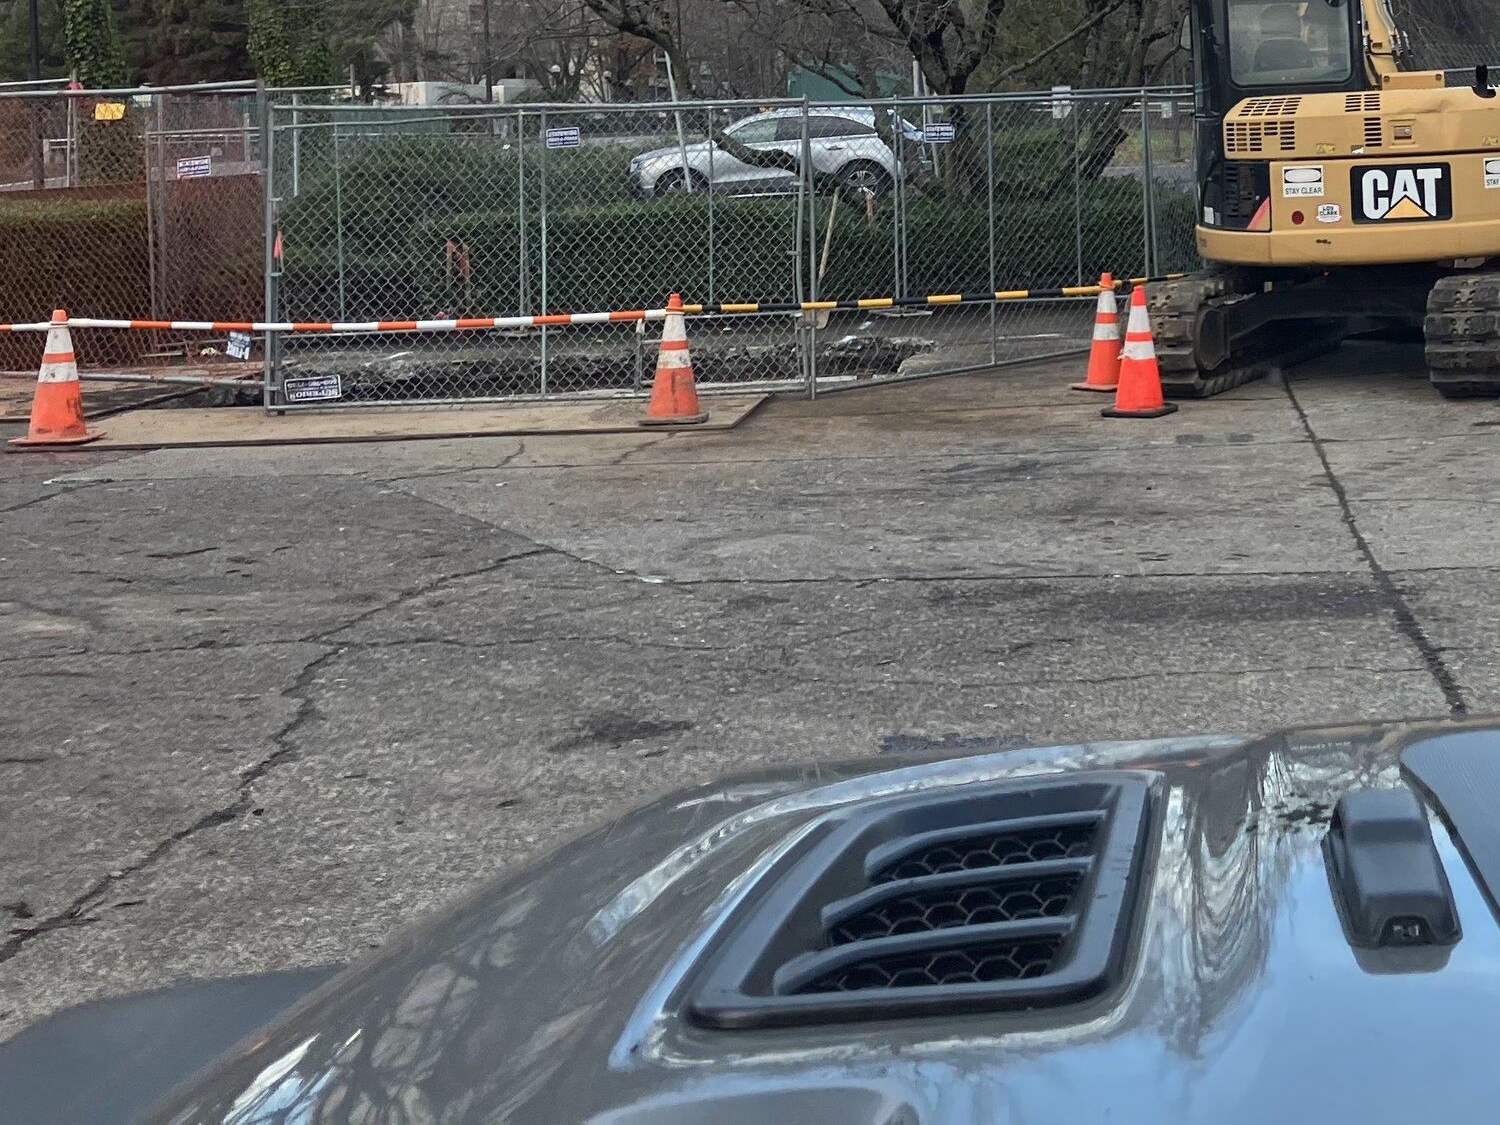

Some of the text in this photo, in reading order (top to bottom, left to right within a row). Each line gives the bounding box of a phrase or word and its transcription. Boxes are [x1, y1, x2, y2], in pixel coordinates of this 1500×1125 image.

[1486, 178, 1499, 186] STAY
[1285, 187, 1299, 195] STAY
[1362, 168, 1442, 219] CAT
[289, 388, 338, 400] SUPERIOR
